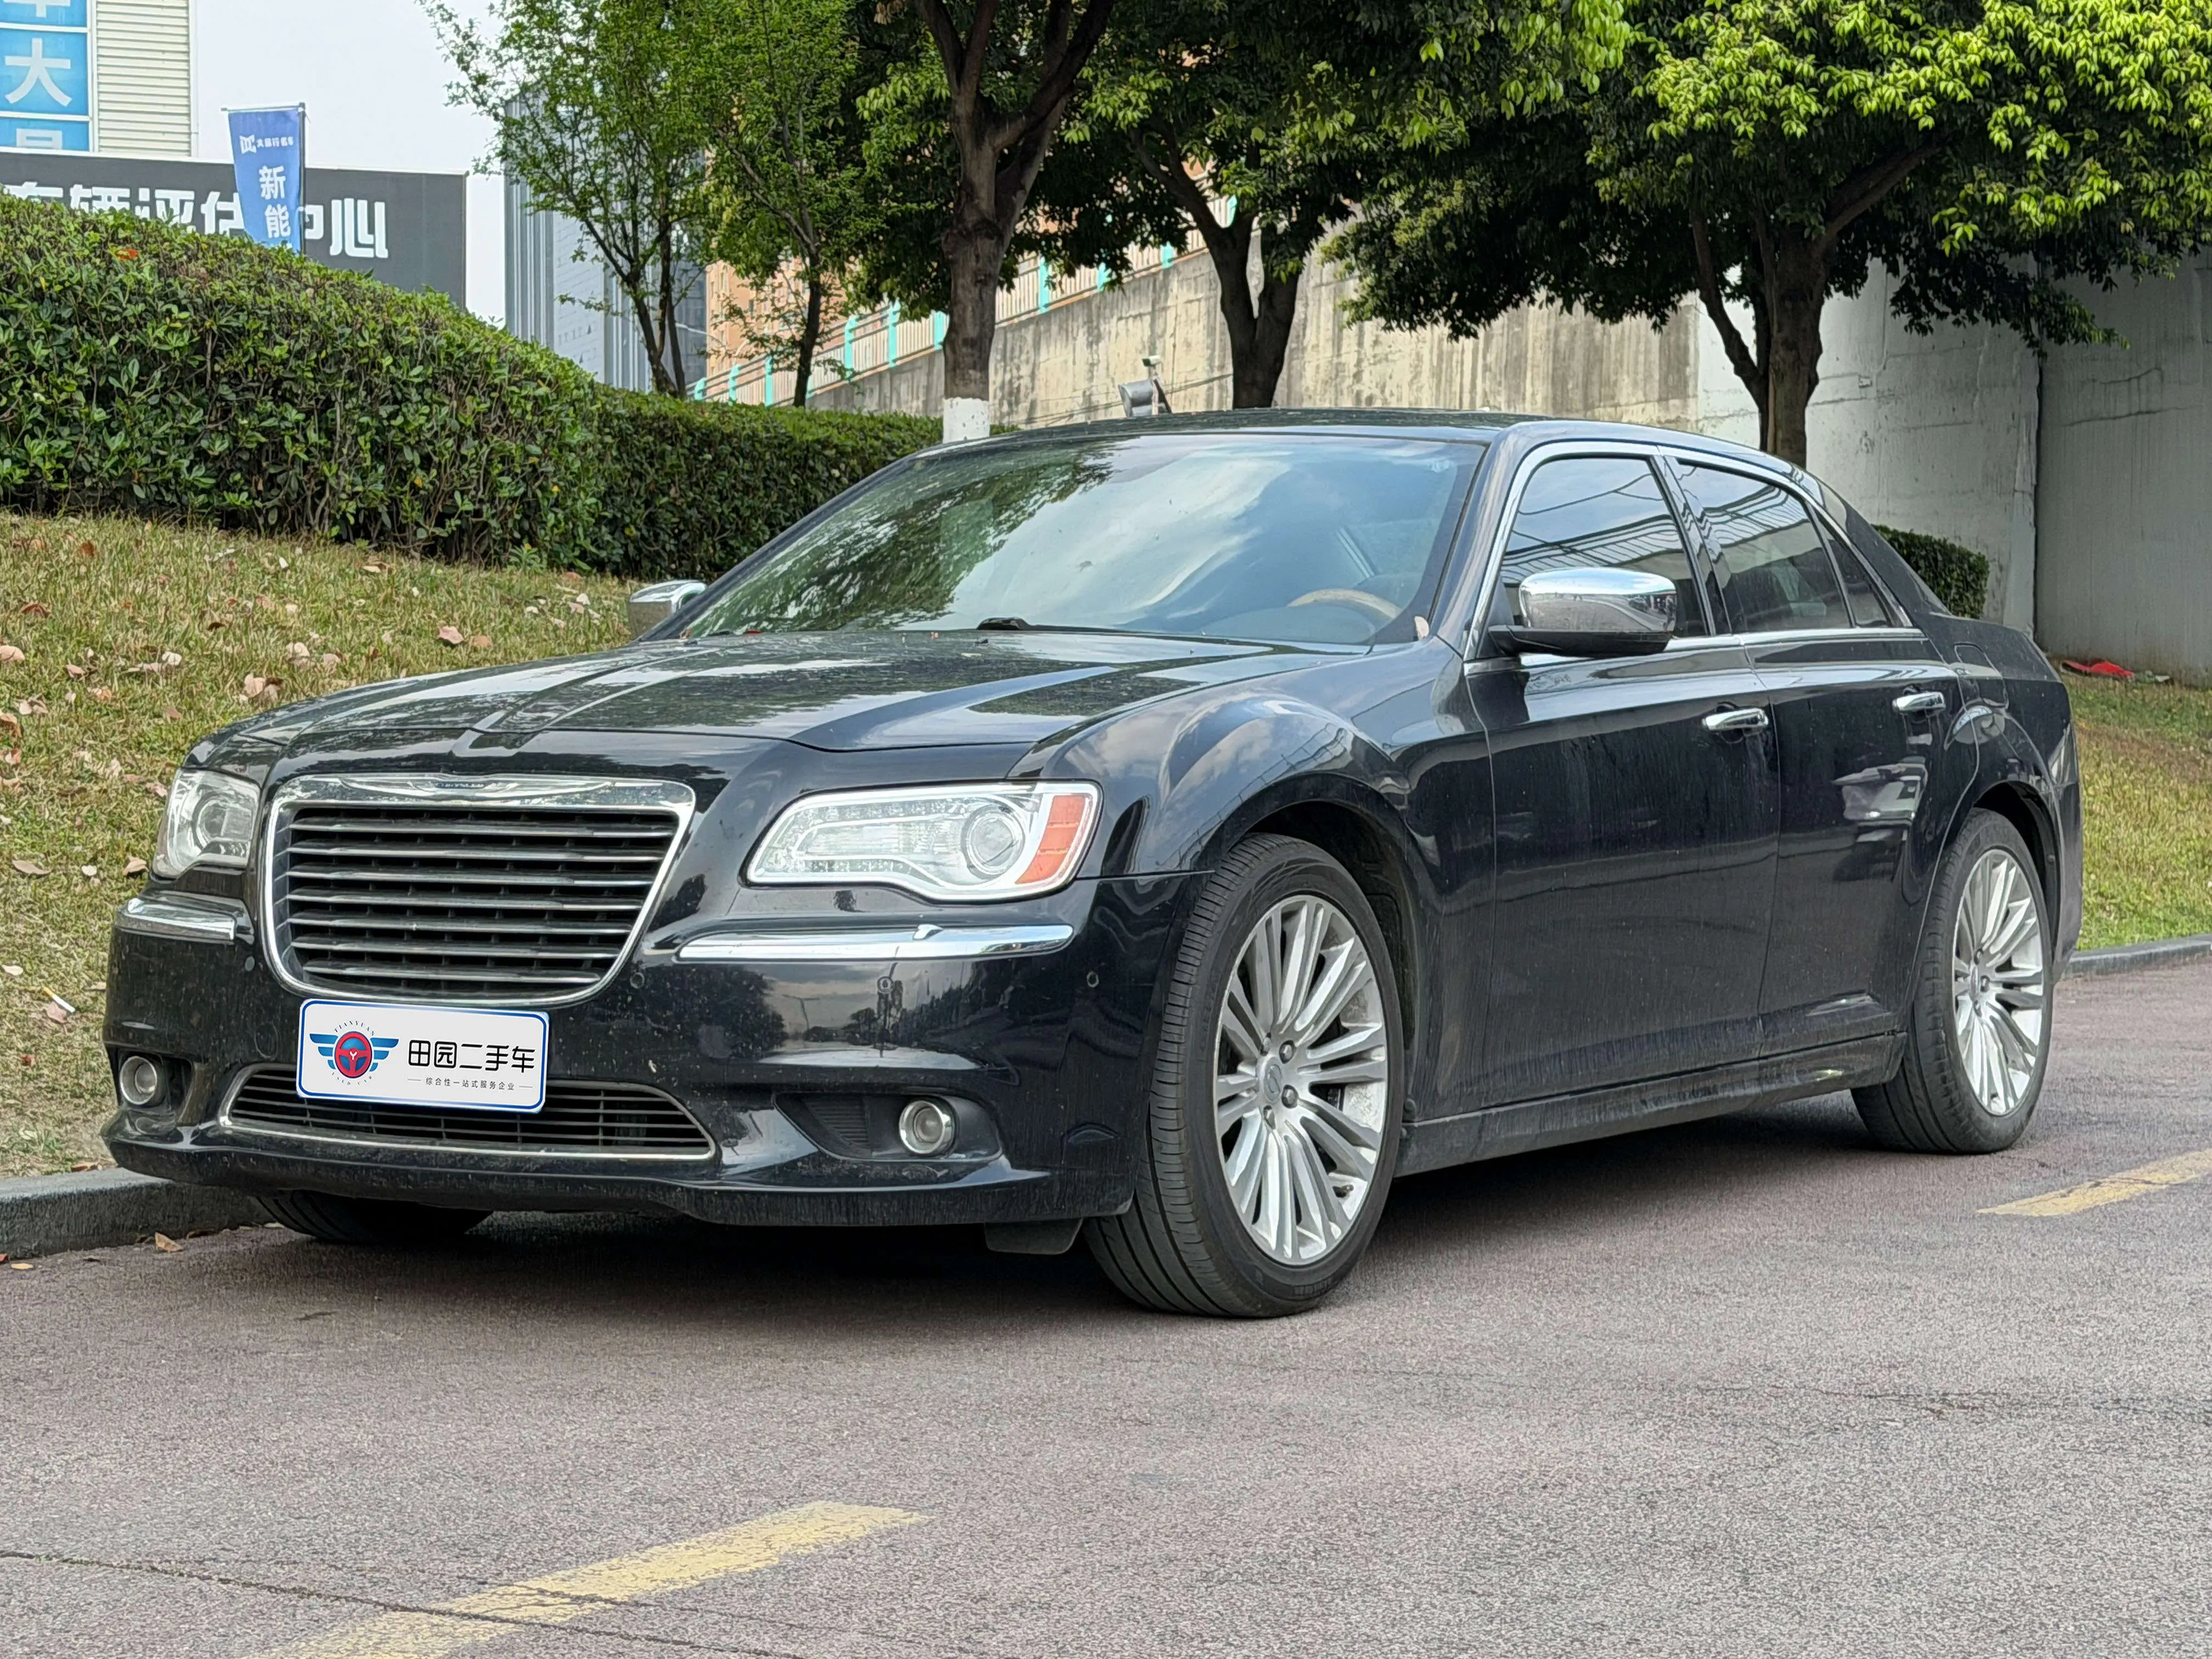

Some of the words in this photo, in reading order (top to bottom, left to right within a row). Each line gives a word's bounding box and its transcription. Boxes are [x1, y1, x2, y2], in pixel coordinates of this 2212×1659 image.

[258, 165, 292, 251] 新能
[408, 1040, 535, 1073] 田园二手车
[426, 1077, 515, 1091] 综合性一站式服务企业
